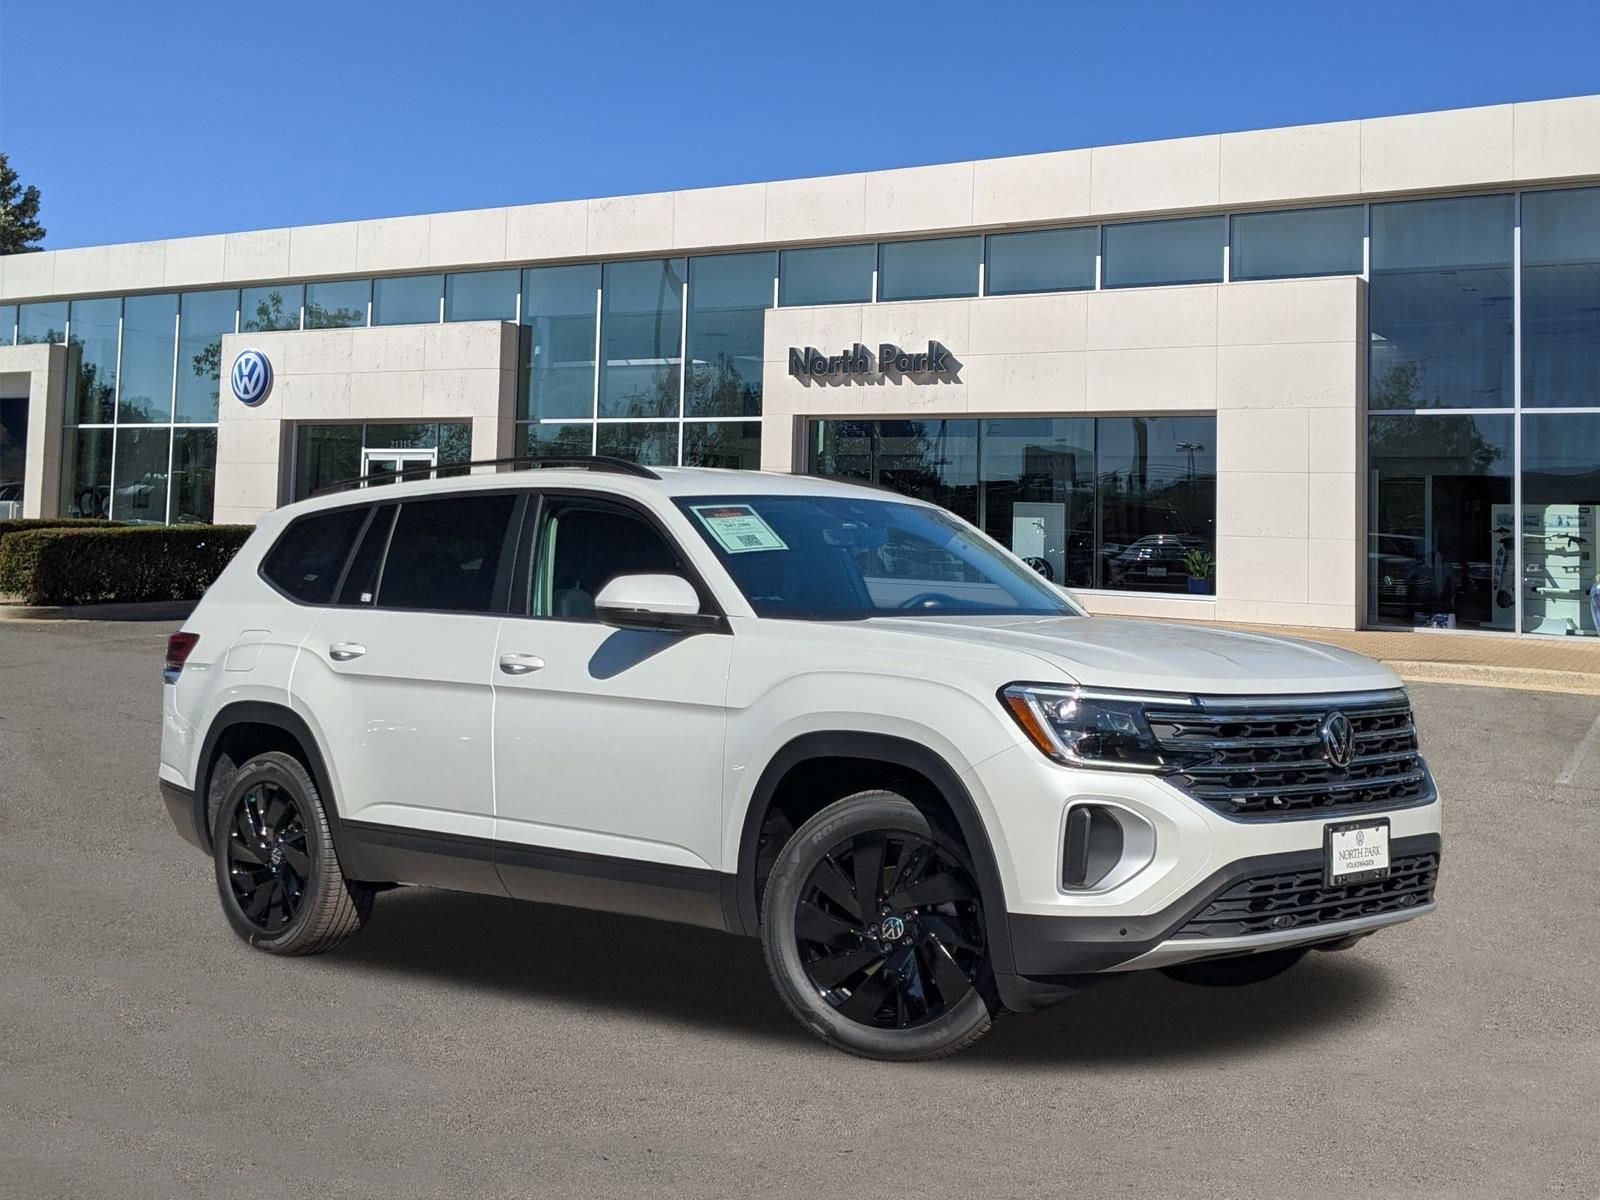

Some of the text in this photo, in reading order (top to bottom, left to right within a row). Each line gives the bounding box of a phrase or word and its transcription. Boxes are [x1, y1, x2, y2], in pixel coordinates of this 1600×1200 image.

[788, 339, 947, 376] North Park
[390, 439, 412, 448] 21315
[1338, 845, 1382, 861] NORTH PARK
[1346, 859, 1375, 869] VOLKSWAGEN
